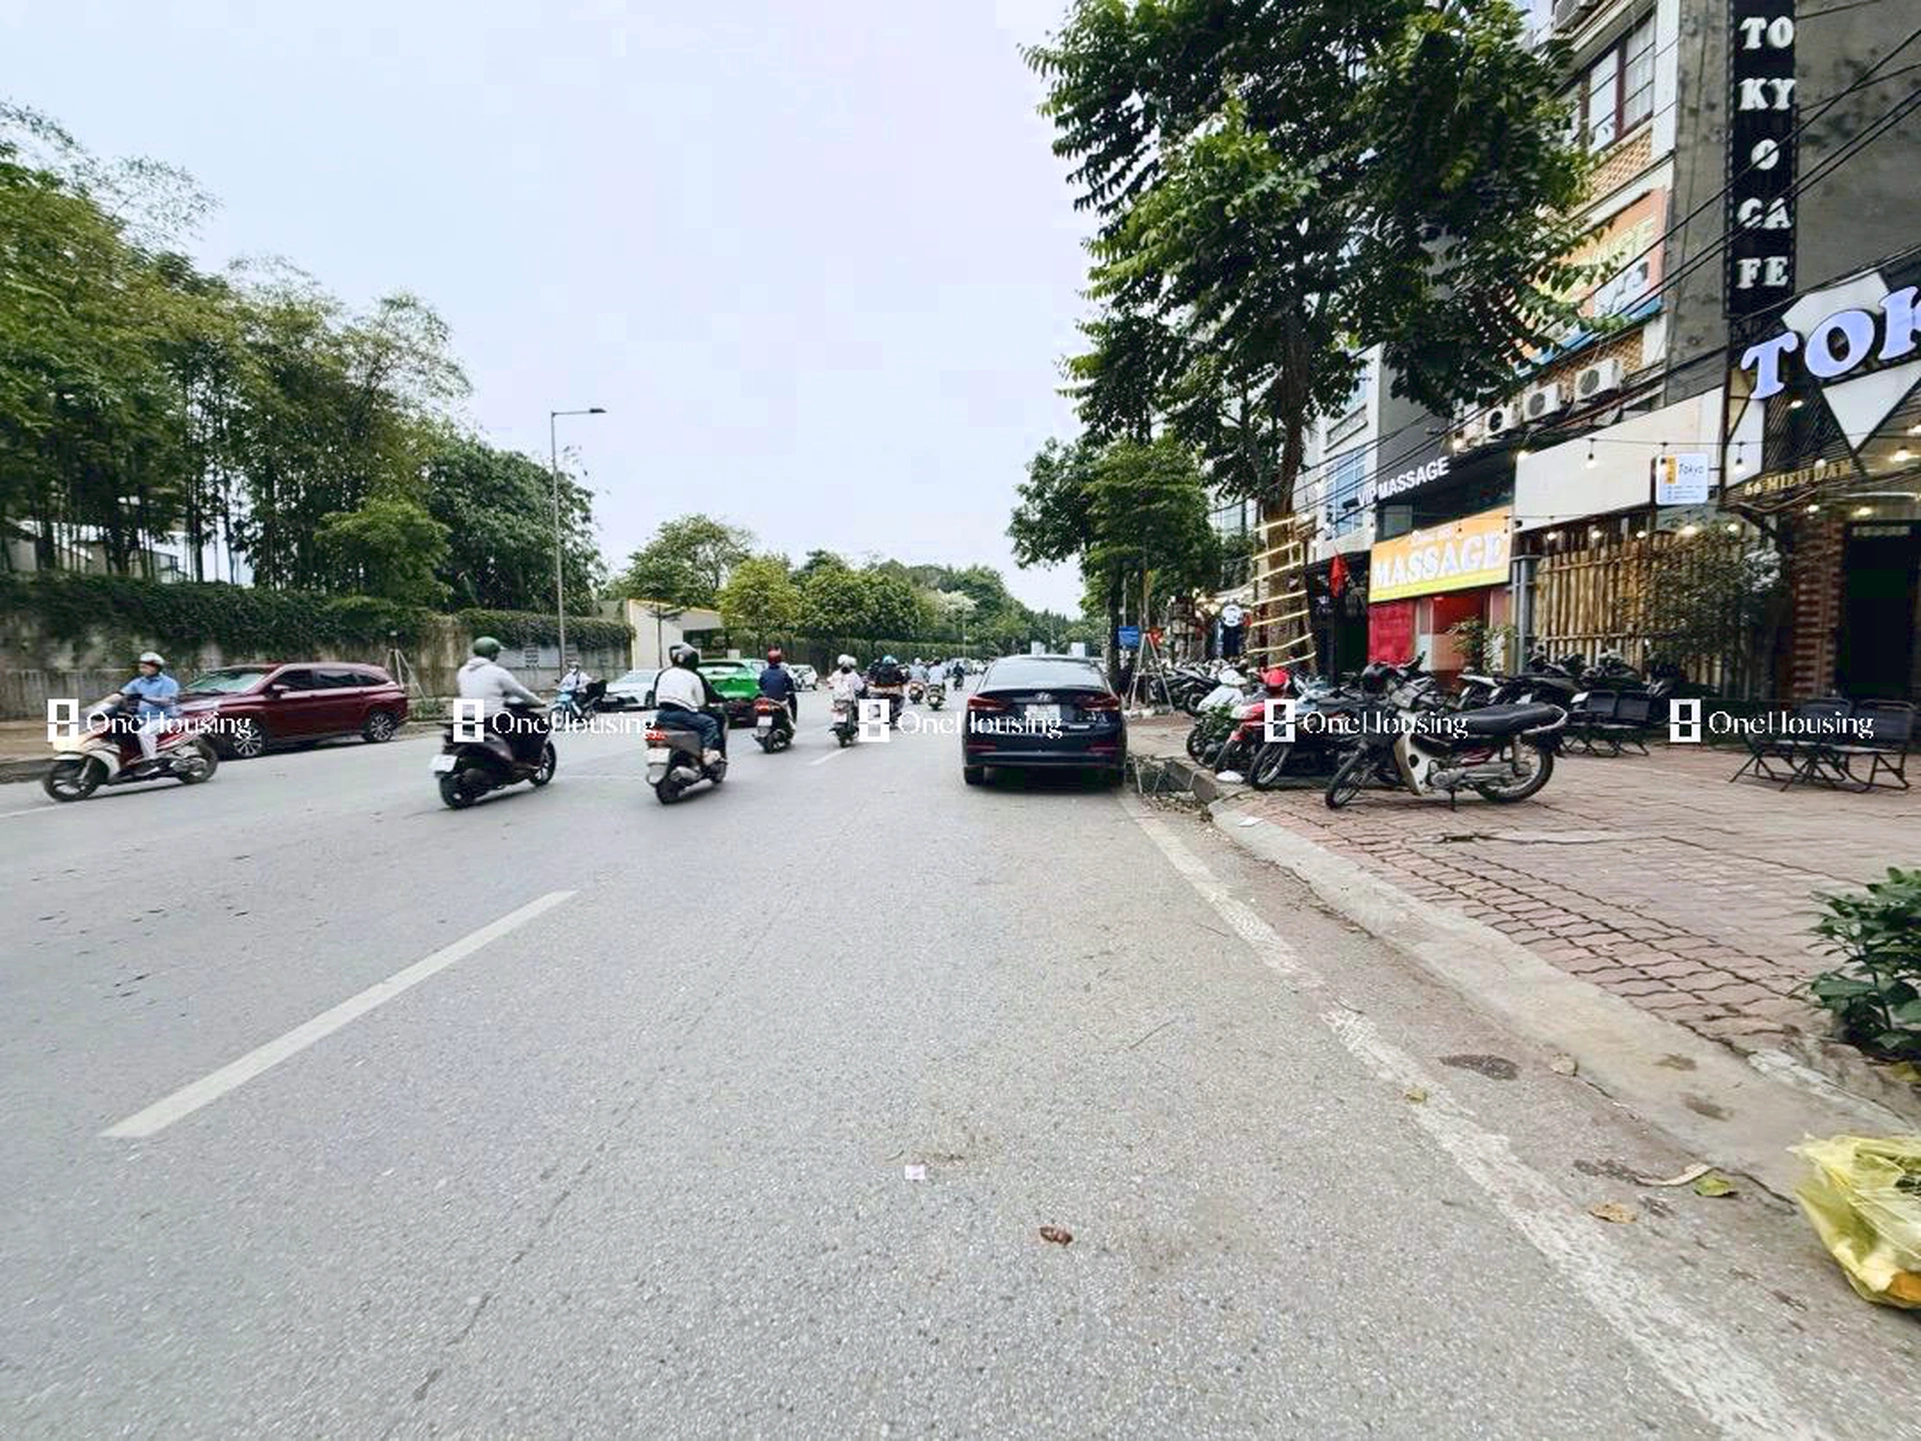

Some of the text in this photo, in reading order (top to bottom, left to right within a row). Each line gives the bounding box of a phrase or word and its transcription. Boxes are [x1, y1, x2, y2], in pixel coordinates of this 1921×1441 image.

[1739, 15, 1794, 49] TO
[1738, 77, 1797, 111] KY
[1750, 138, 1780, 170] O
[1737, 197, 1792, 229] CA
[1736, 255, 1789, 289] FE
[1740, 285, 1921, 400] TOK
[1357, 456, 1451, 507] VIP MASSAGE
[1373, 531, 1507, 588] MASSAGE
